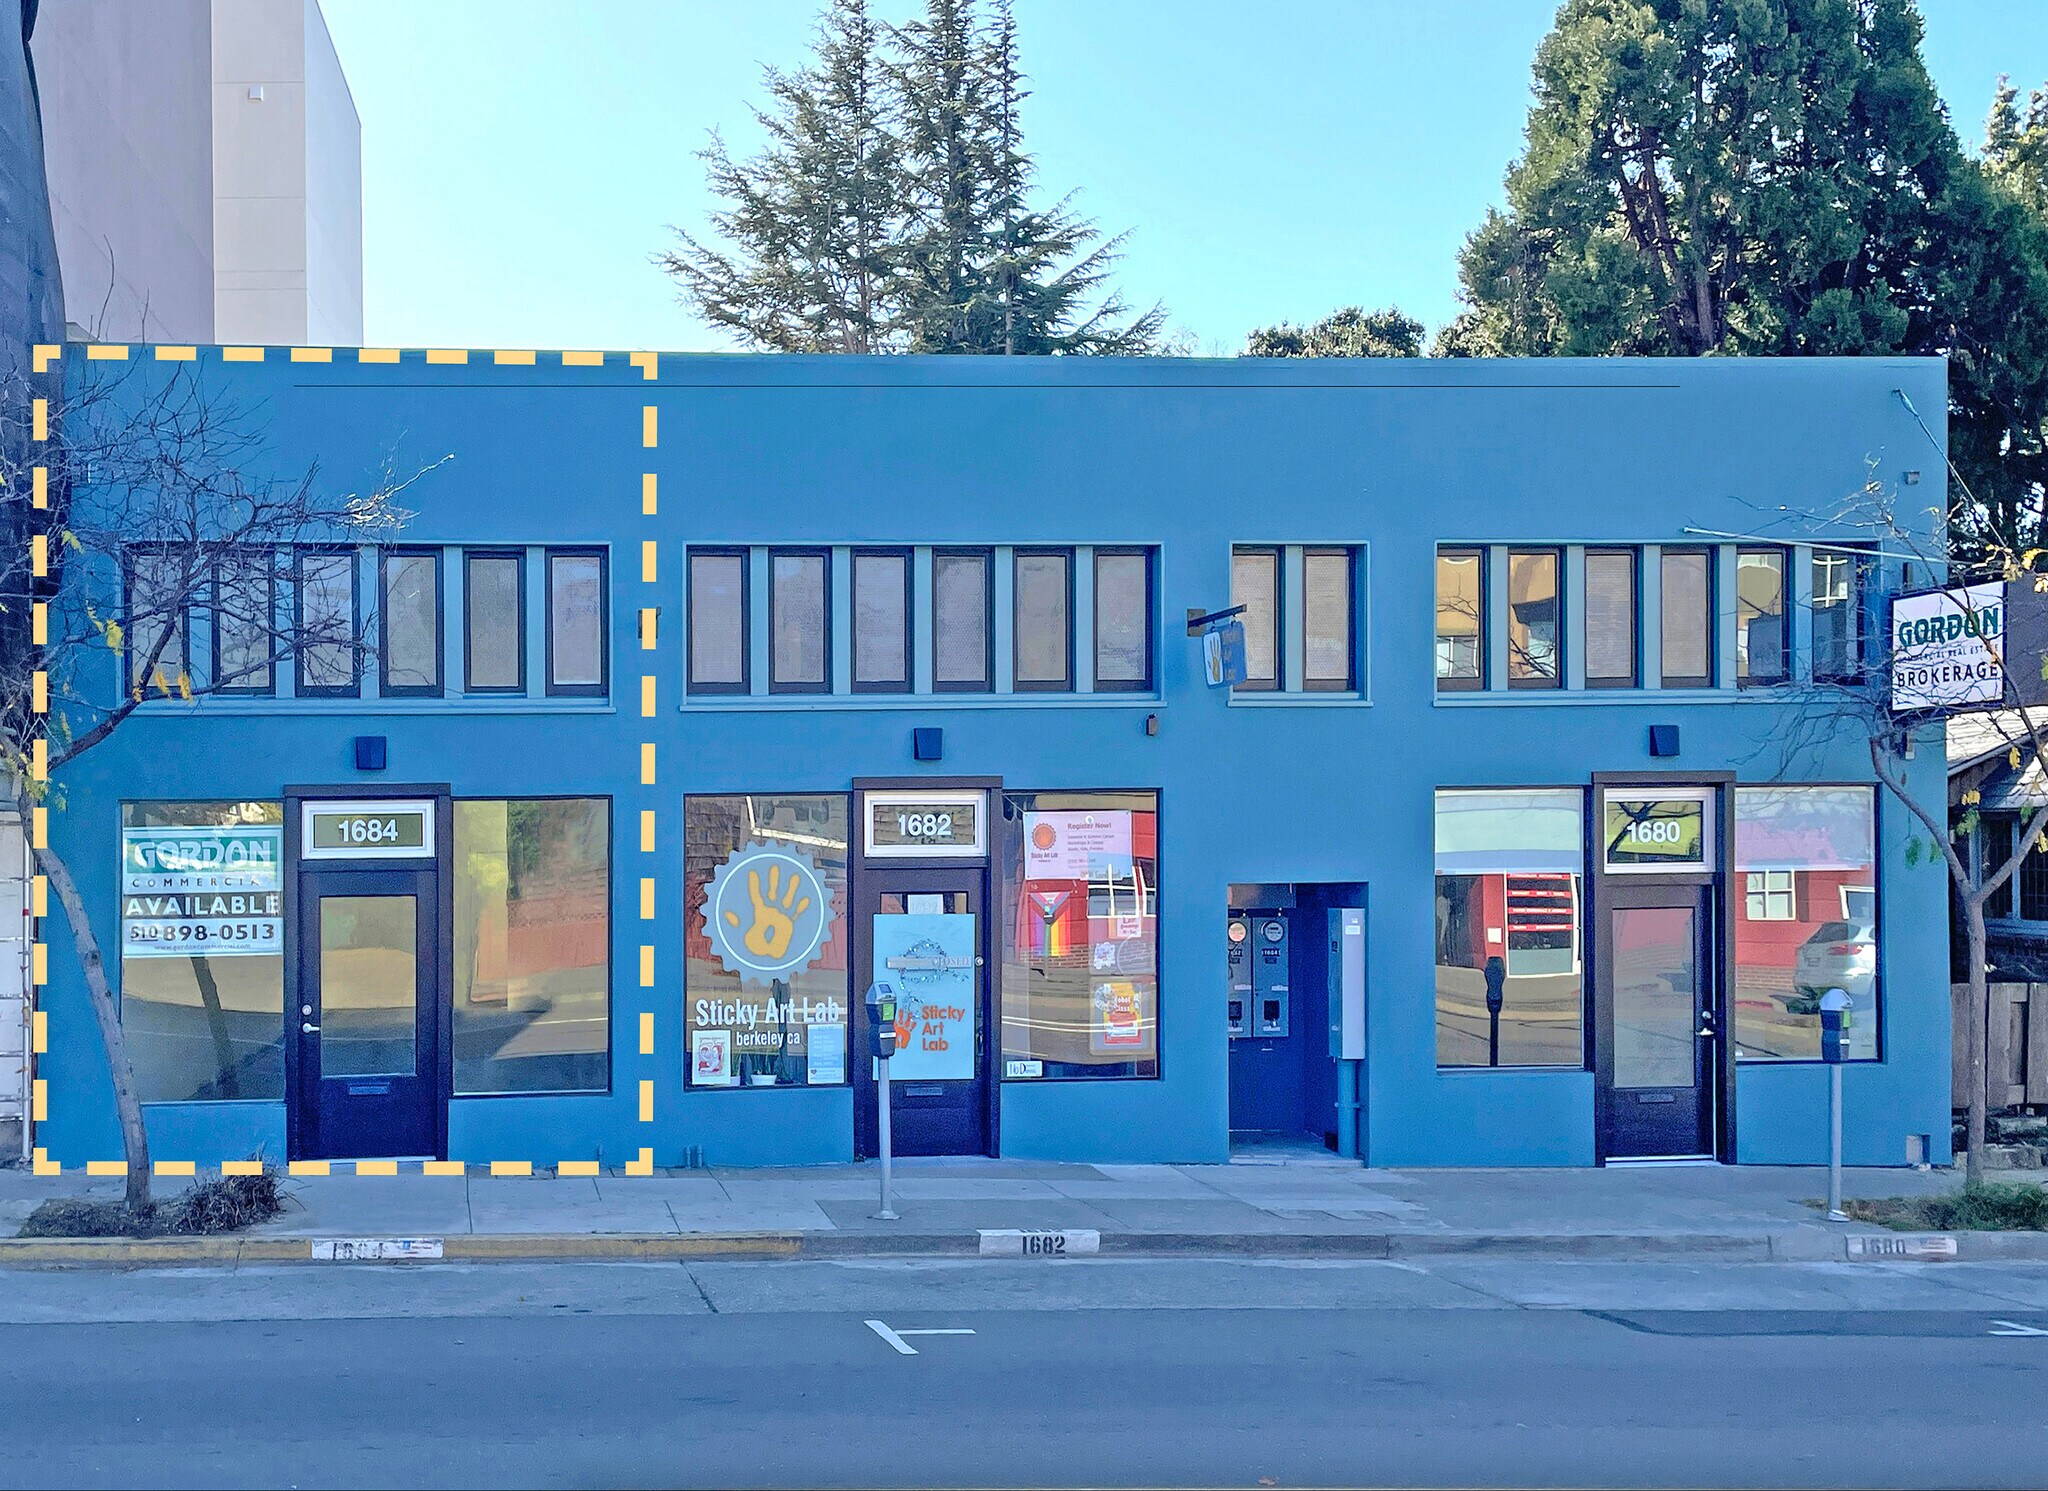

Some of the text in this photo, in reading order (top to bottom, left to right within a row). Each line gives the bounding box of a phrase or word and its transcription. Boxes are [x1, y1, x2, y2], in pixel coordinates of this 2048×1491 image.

[1899, 608, 1998, 647] GORDON
[1970, 643, 1998, 655] ESTE
[1897, 661, 1998, 688] BROKERAGE
[338, 819, 398, 842] 1684
[898, 813, 952, 836] 1682
[1626, 821, 1680, 843] 1680
[134, 840, 271, 869] GORDON
[132, 878, 262, 888] COMMERCIA
[125, 895, 279, 916] AVAILABLE
[130, 924, 275, 942] 510 898-0513
[695, 997, 839, 1030] Sticky Art Lab
[921, 1004, 966, 1022] Sticky
[921, 1021, 944, 1036] Art
[736, 1031, 783, 1048] berkeley
[787, 1032, 800, 1044] ca
[922, 1038, 949, 1052] Lab
[1022, 1236, 1066, 1255] 1682
